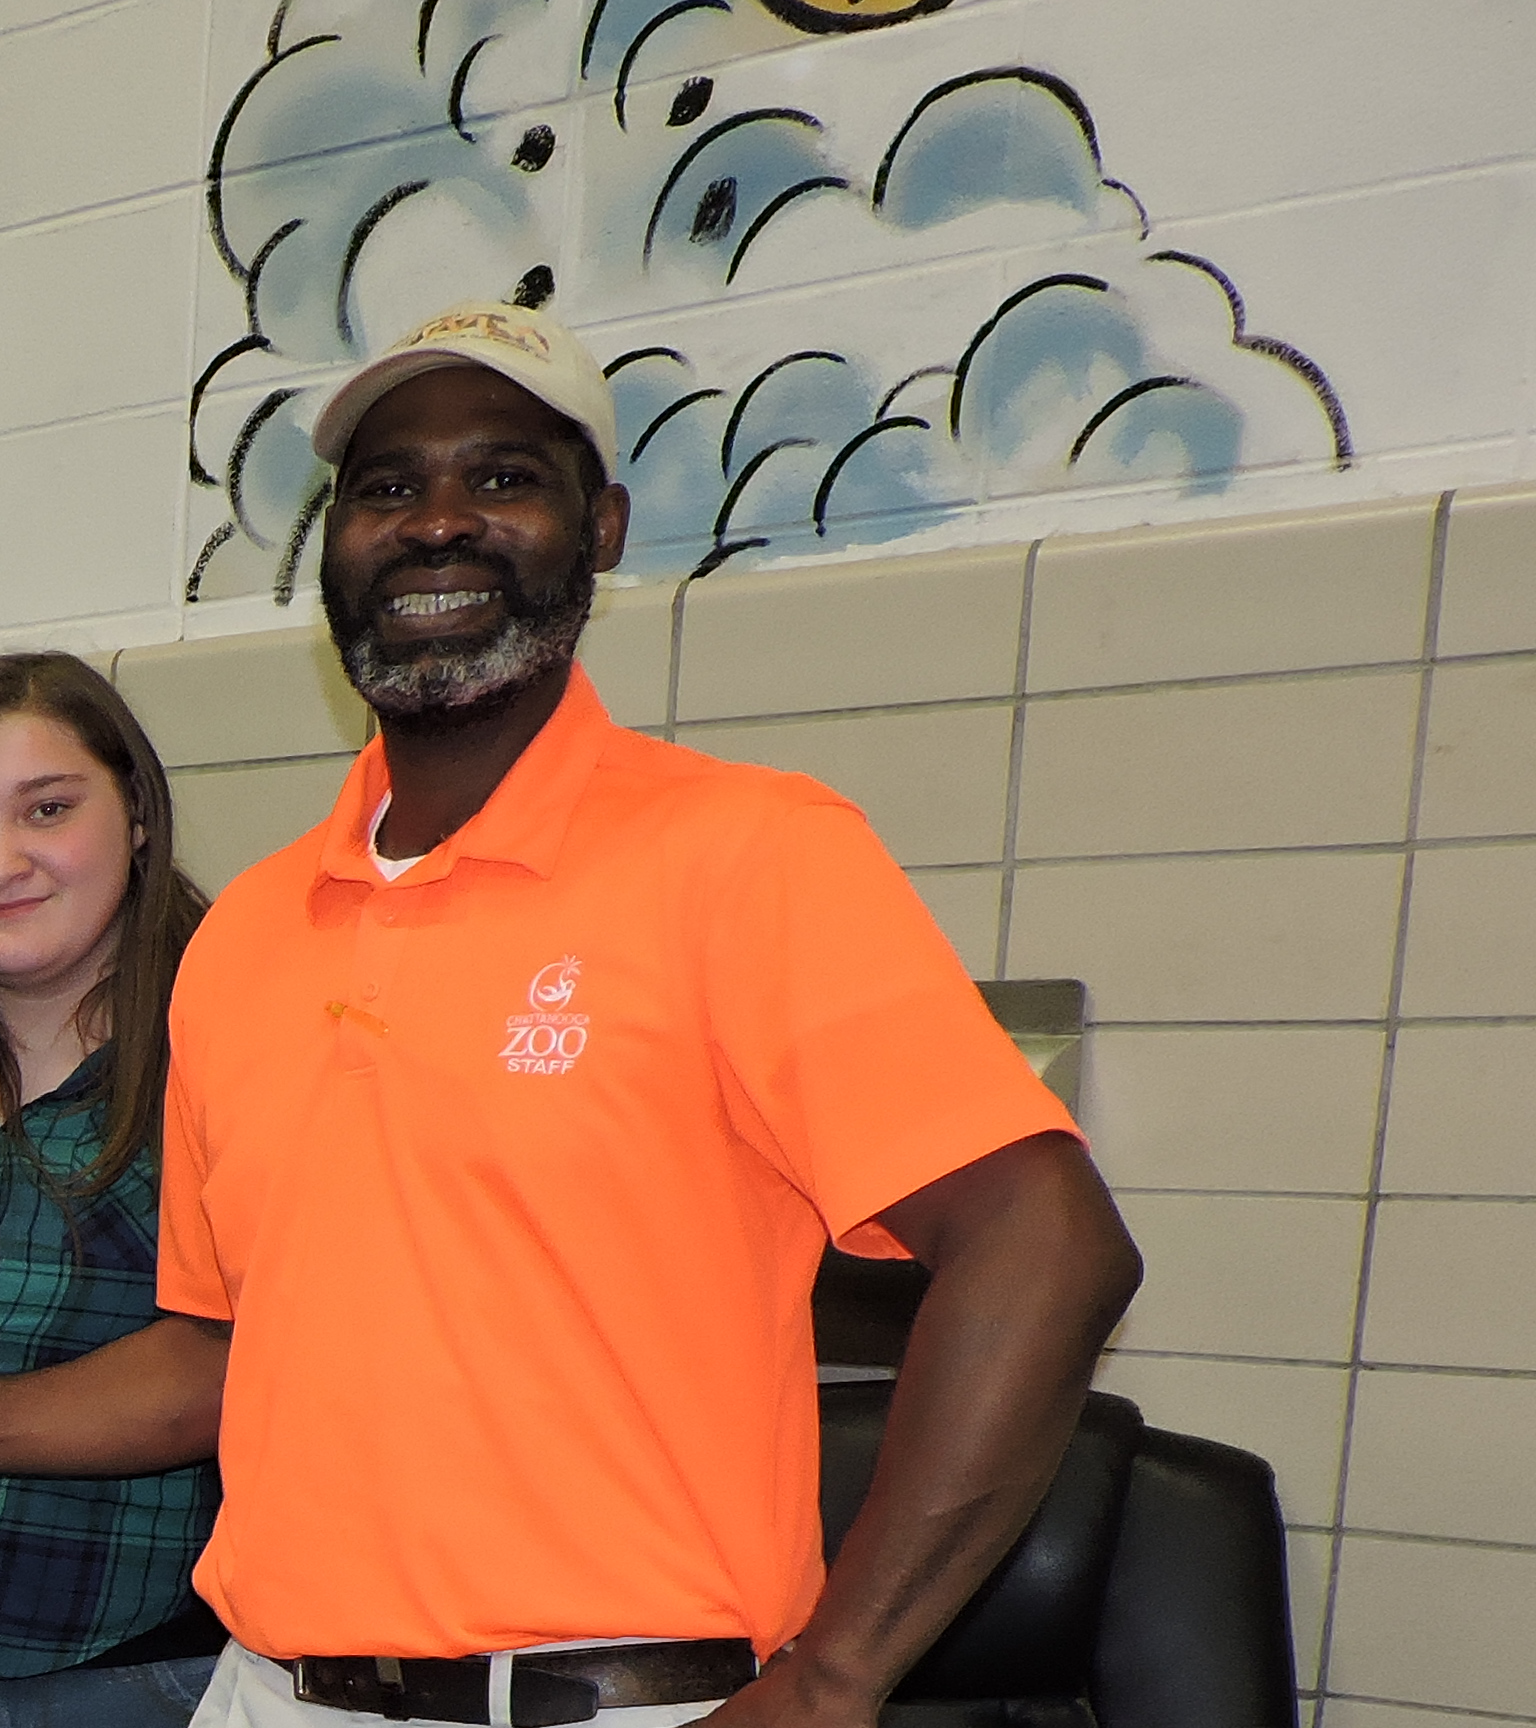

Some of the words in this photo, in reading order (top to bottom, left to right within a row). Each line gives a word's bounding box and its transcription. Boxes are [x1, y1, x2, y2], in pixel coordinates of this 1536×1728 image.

[506, 1012, 590, 1026] CHATTANOOGA
[498, 1025, 589, 1059] ZOO
[506, 1057, 576, 1075] STAFF
